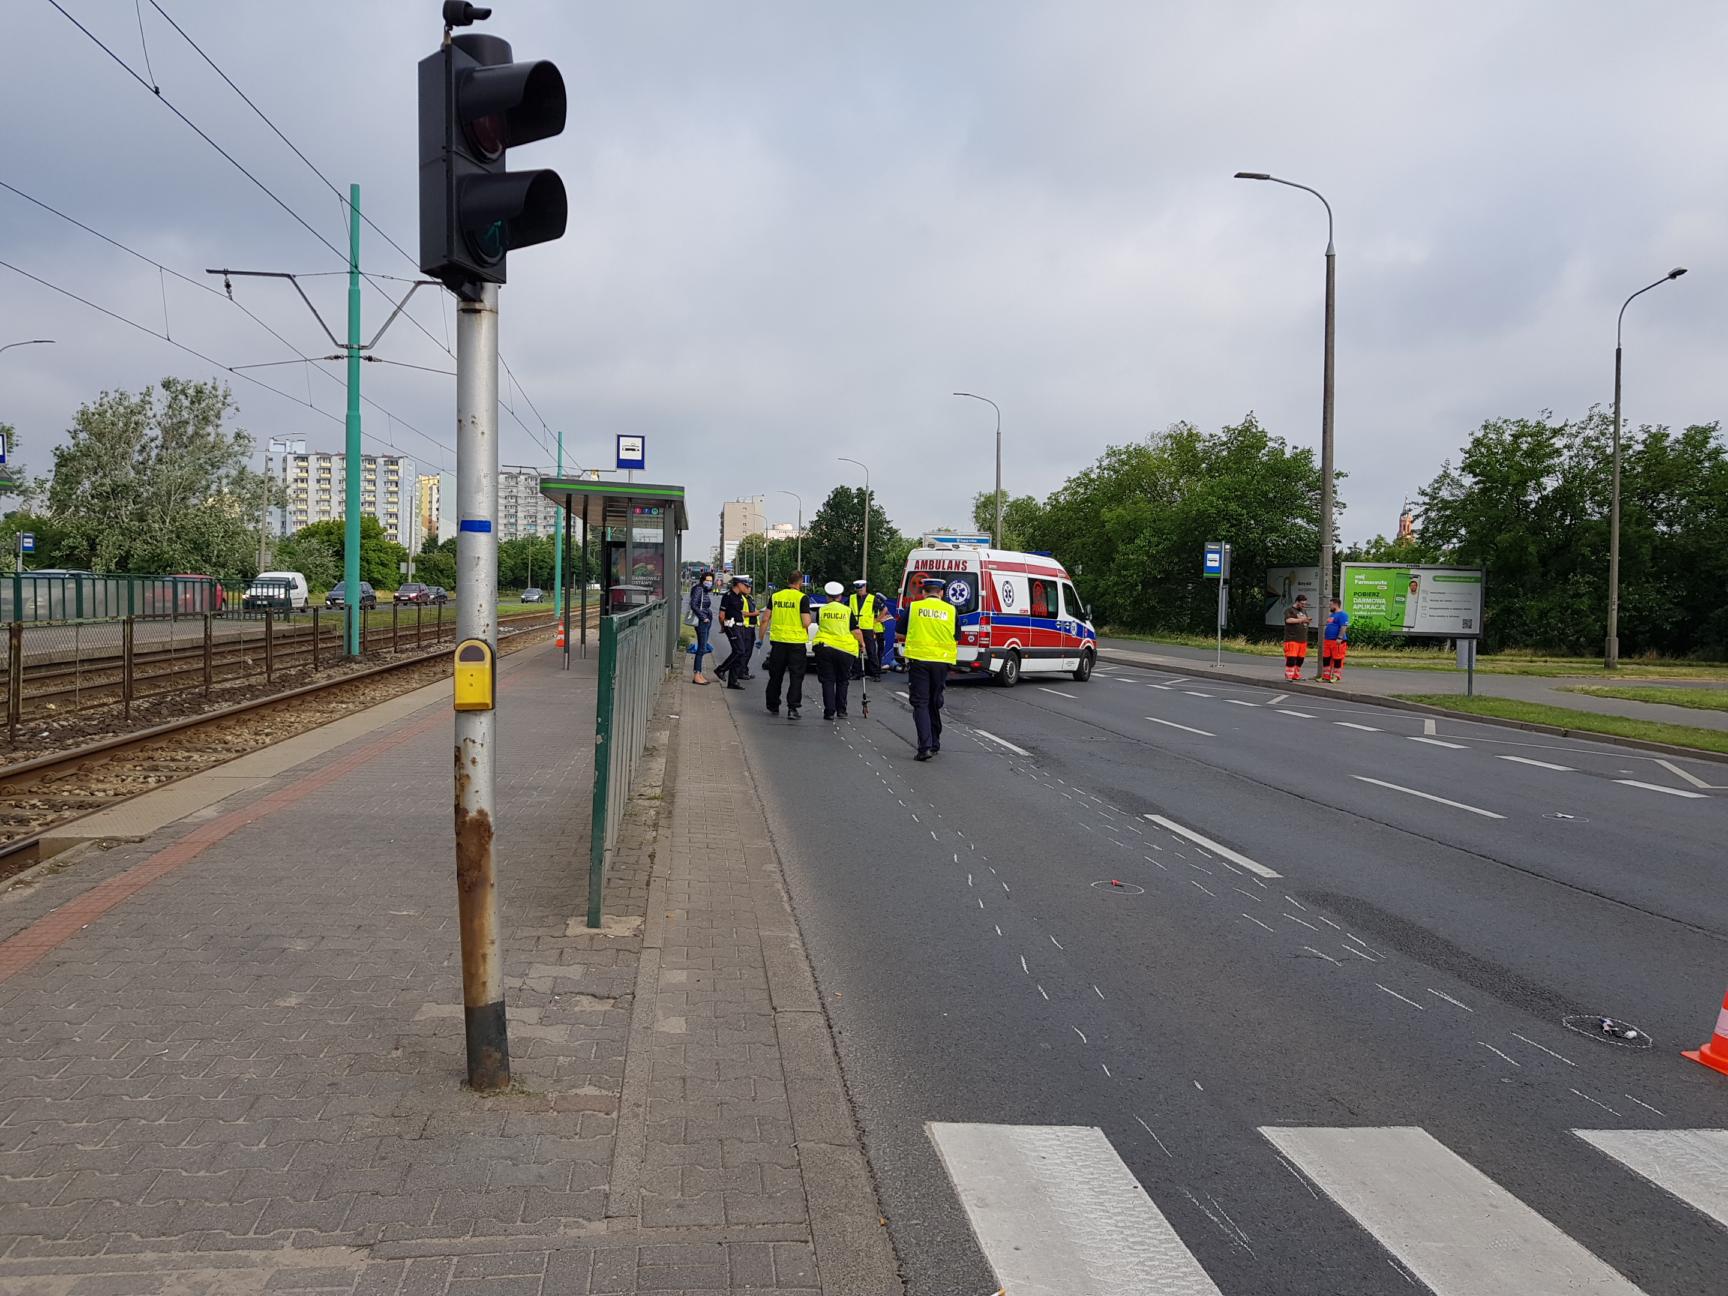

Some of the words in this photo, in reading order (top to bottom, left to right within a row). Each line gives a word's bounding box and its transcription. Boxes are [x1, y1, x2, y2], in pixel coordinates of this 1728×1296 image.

[914, 560, 968, 571] AMBULANS
[774, 600, 795, 609] POLICJA
[823, 612, 847, 620] POLICJA
[918, 608, 947, 620] POLICJA
